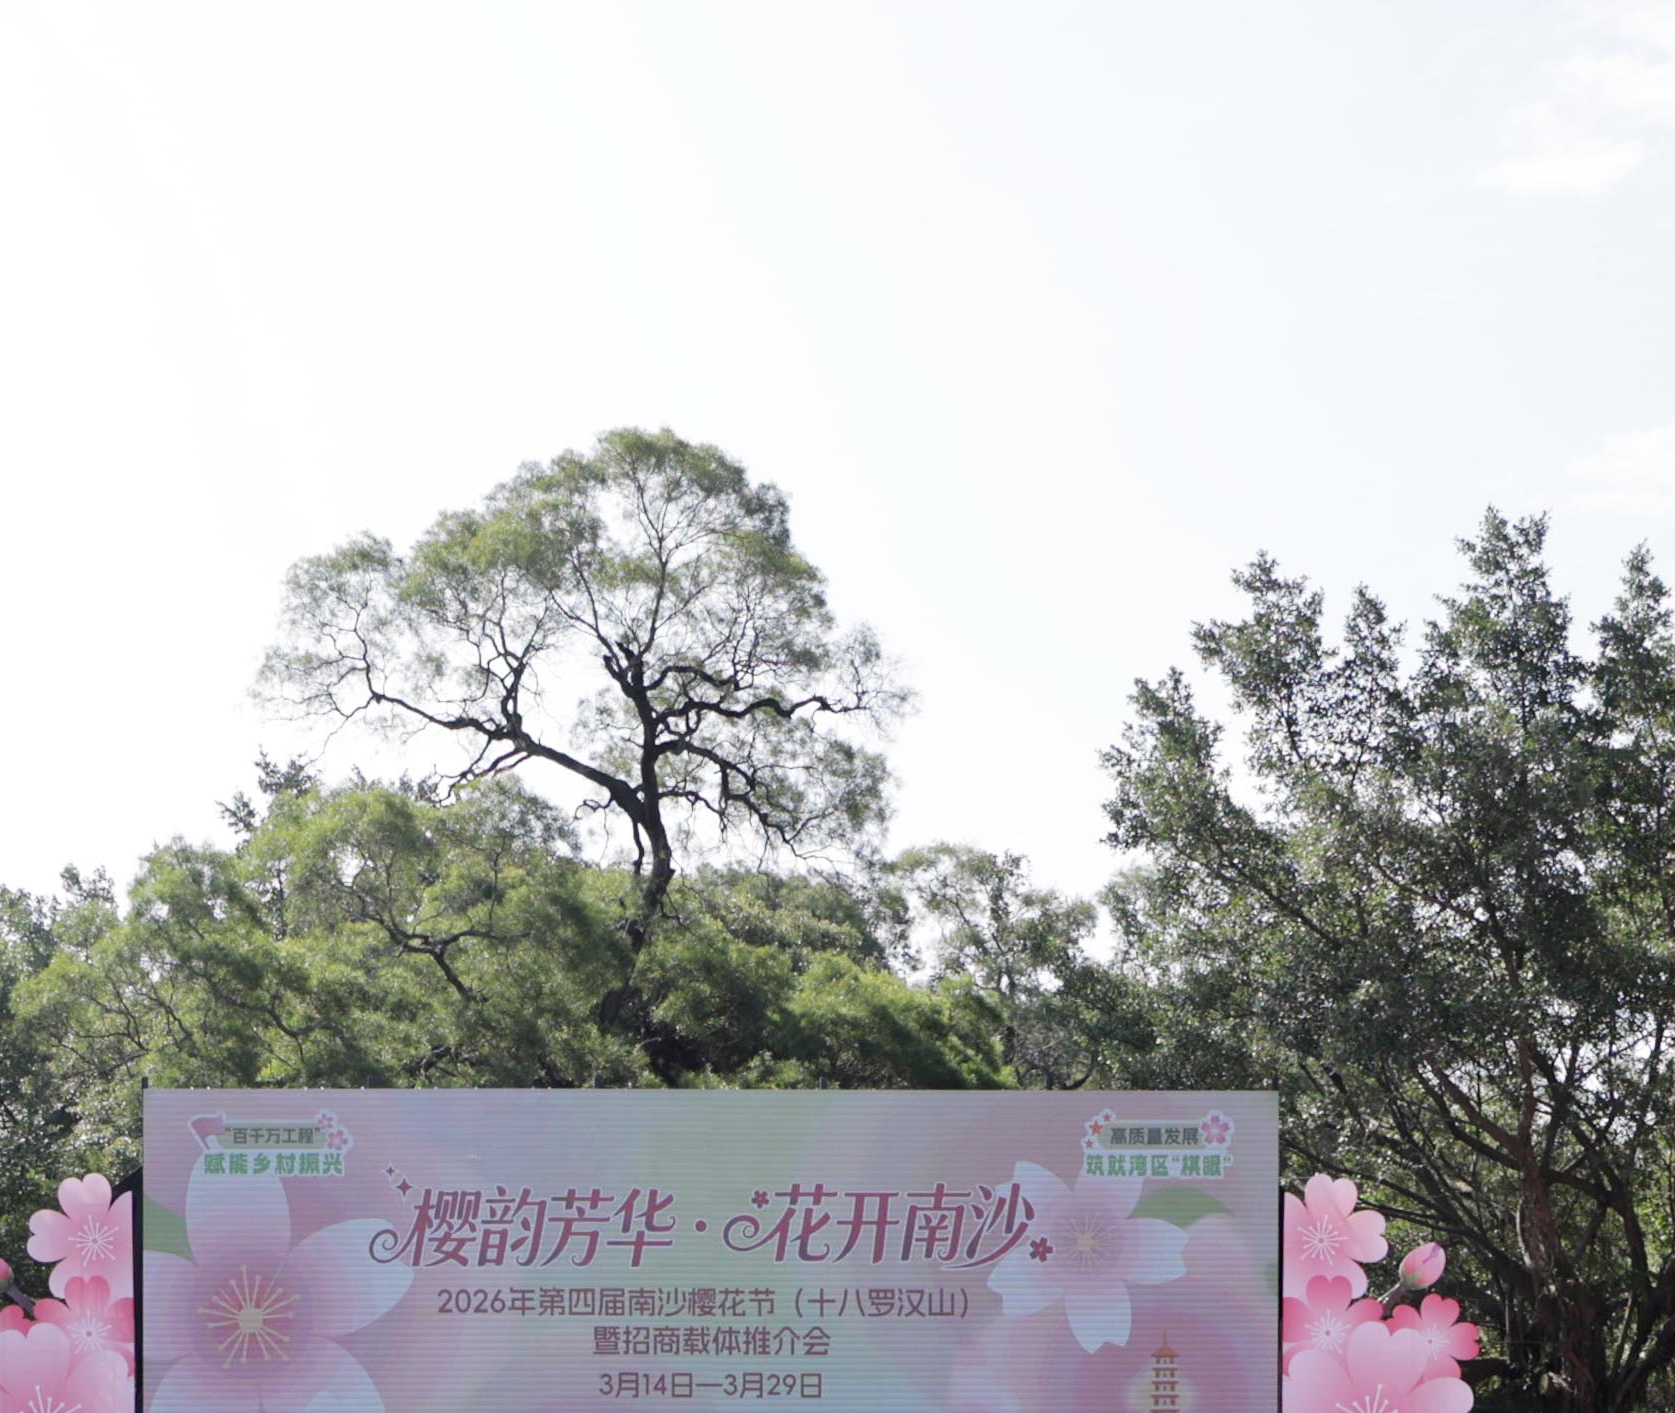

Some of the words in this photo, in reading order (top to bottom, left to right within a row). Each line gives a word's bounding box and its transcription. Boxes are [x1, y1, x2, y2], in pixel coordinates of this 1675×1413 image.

[1110, 1127, 1200, 1146] 高质量发展
[204, 1153, 343, 1175] 赋能乡村振兴
[592, 1325, 832, 1357] 暨招商载体推介会
